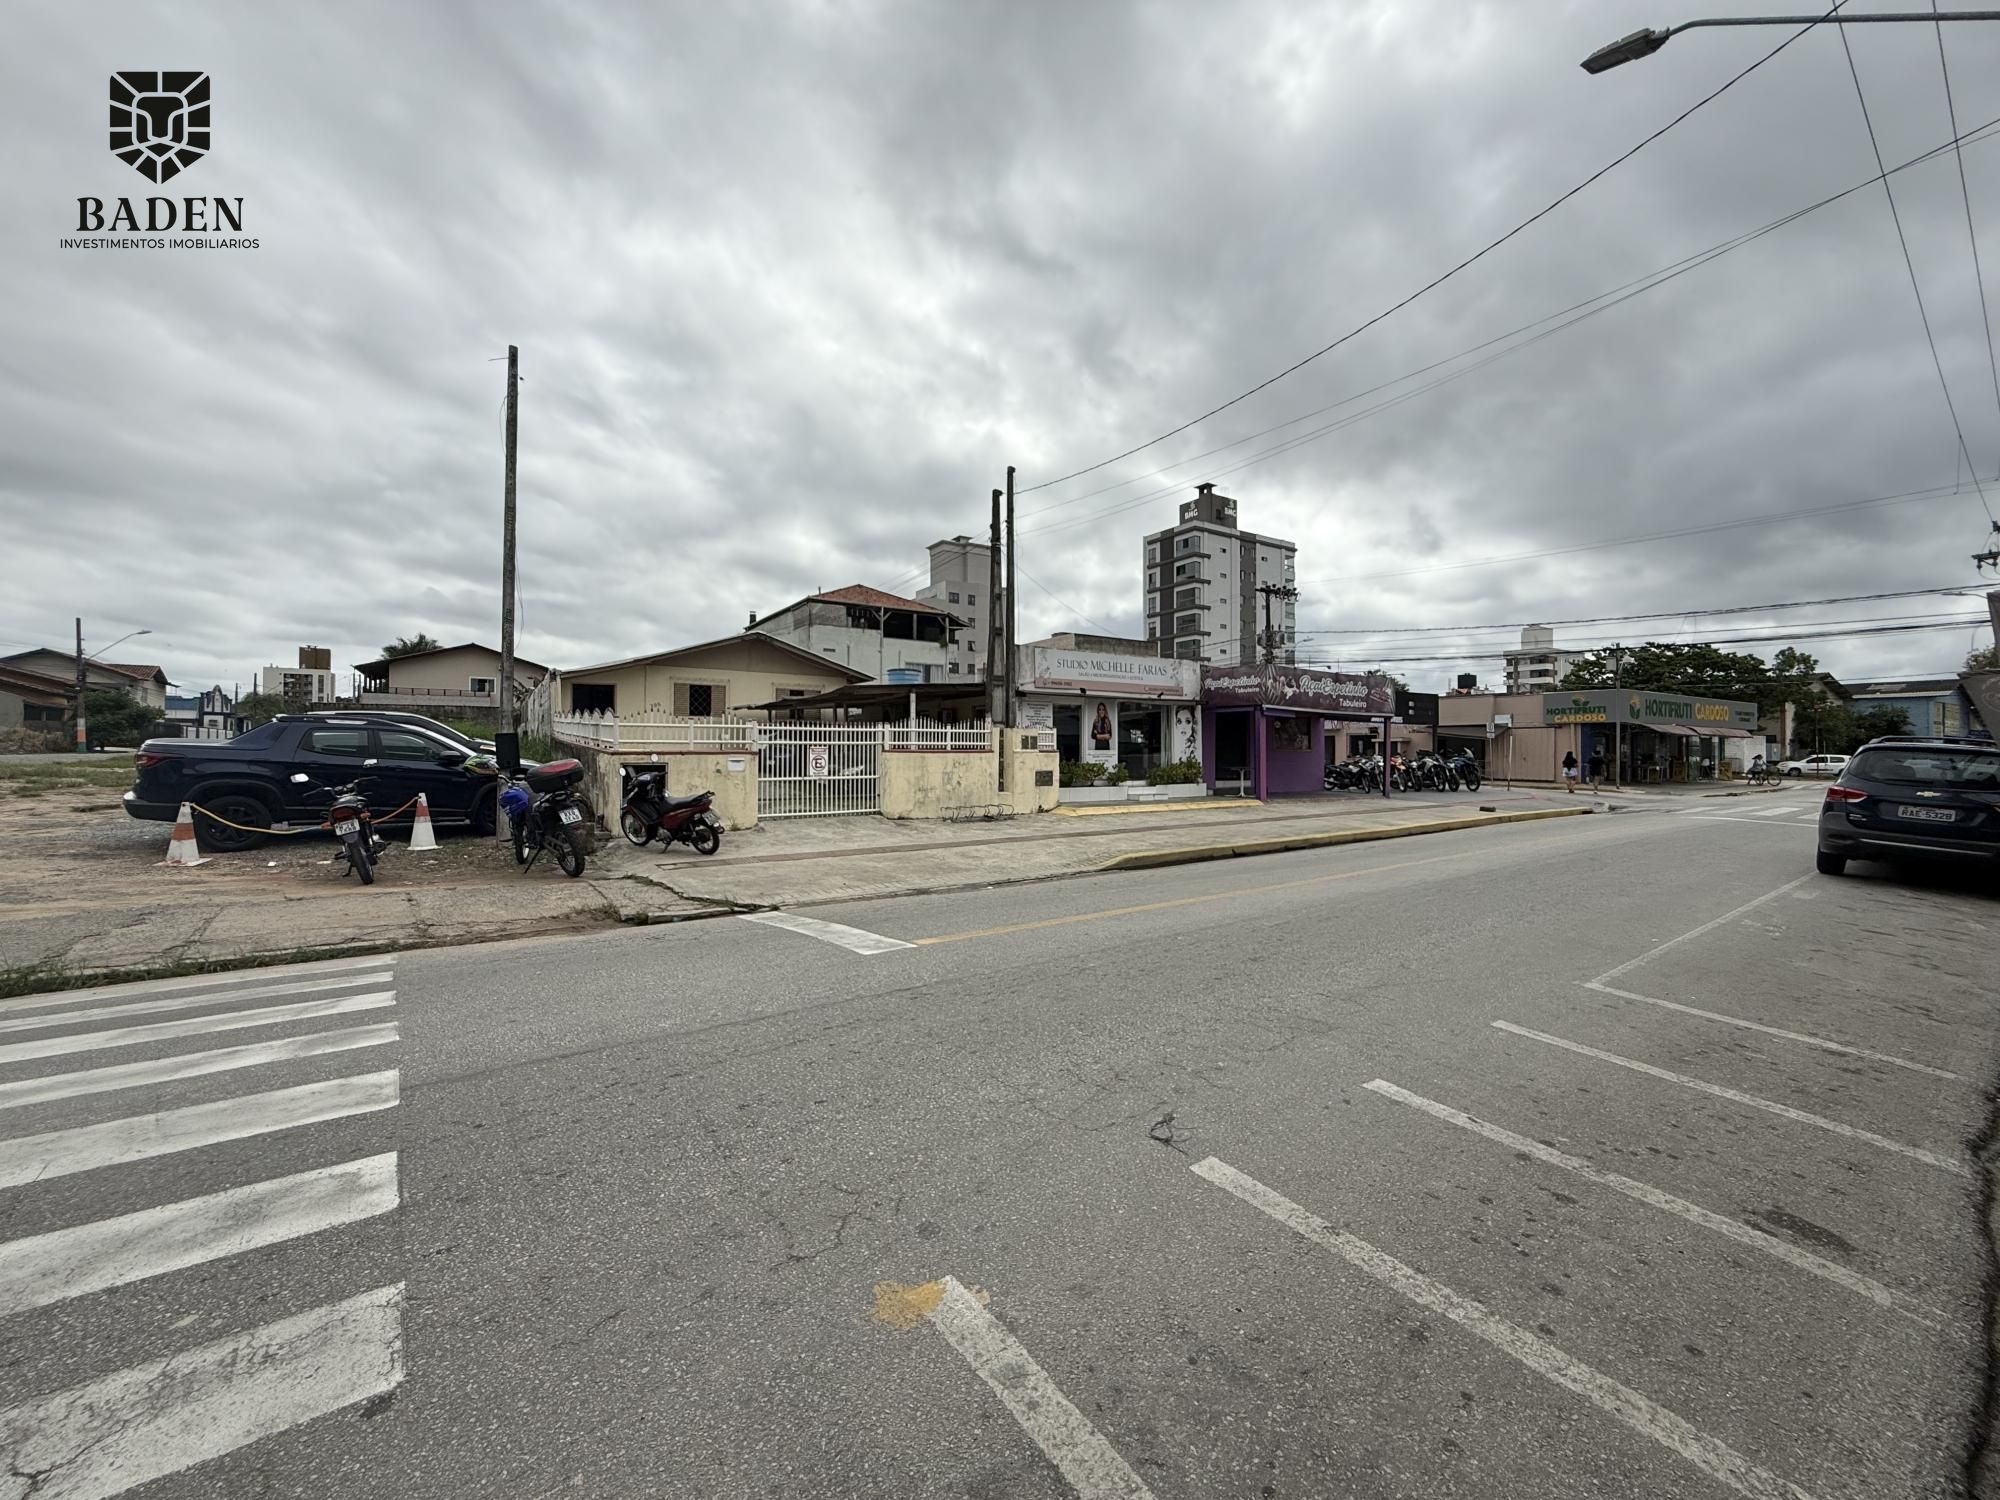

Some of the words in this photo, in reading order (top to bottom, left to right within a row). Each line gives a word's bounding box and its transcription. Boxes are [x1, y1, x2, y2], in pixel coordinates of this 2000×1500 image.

[1184, 508, 1198, 520] BMG
[1056, 658, 1089, 670] STUDIO
[1090, 660, 1135, 674] MICHELLE
[1138, 663, 1168, 676] FARIAS
[1339, 698, 1367, 708] Tabuleiro
[1546, 706, 1607, 715] HORTIFRUTI
[1645, 699, 1693, 719] HORTIFRUTI
[1695, 703, 1729, 721] CARDOSO
[1554, 713, 1607, 723] CARDOSO
